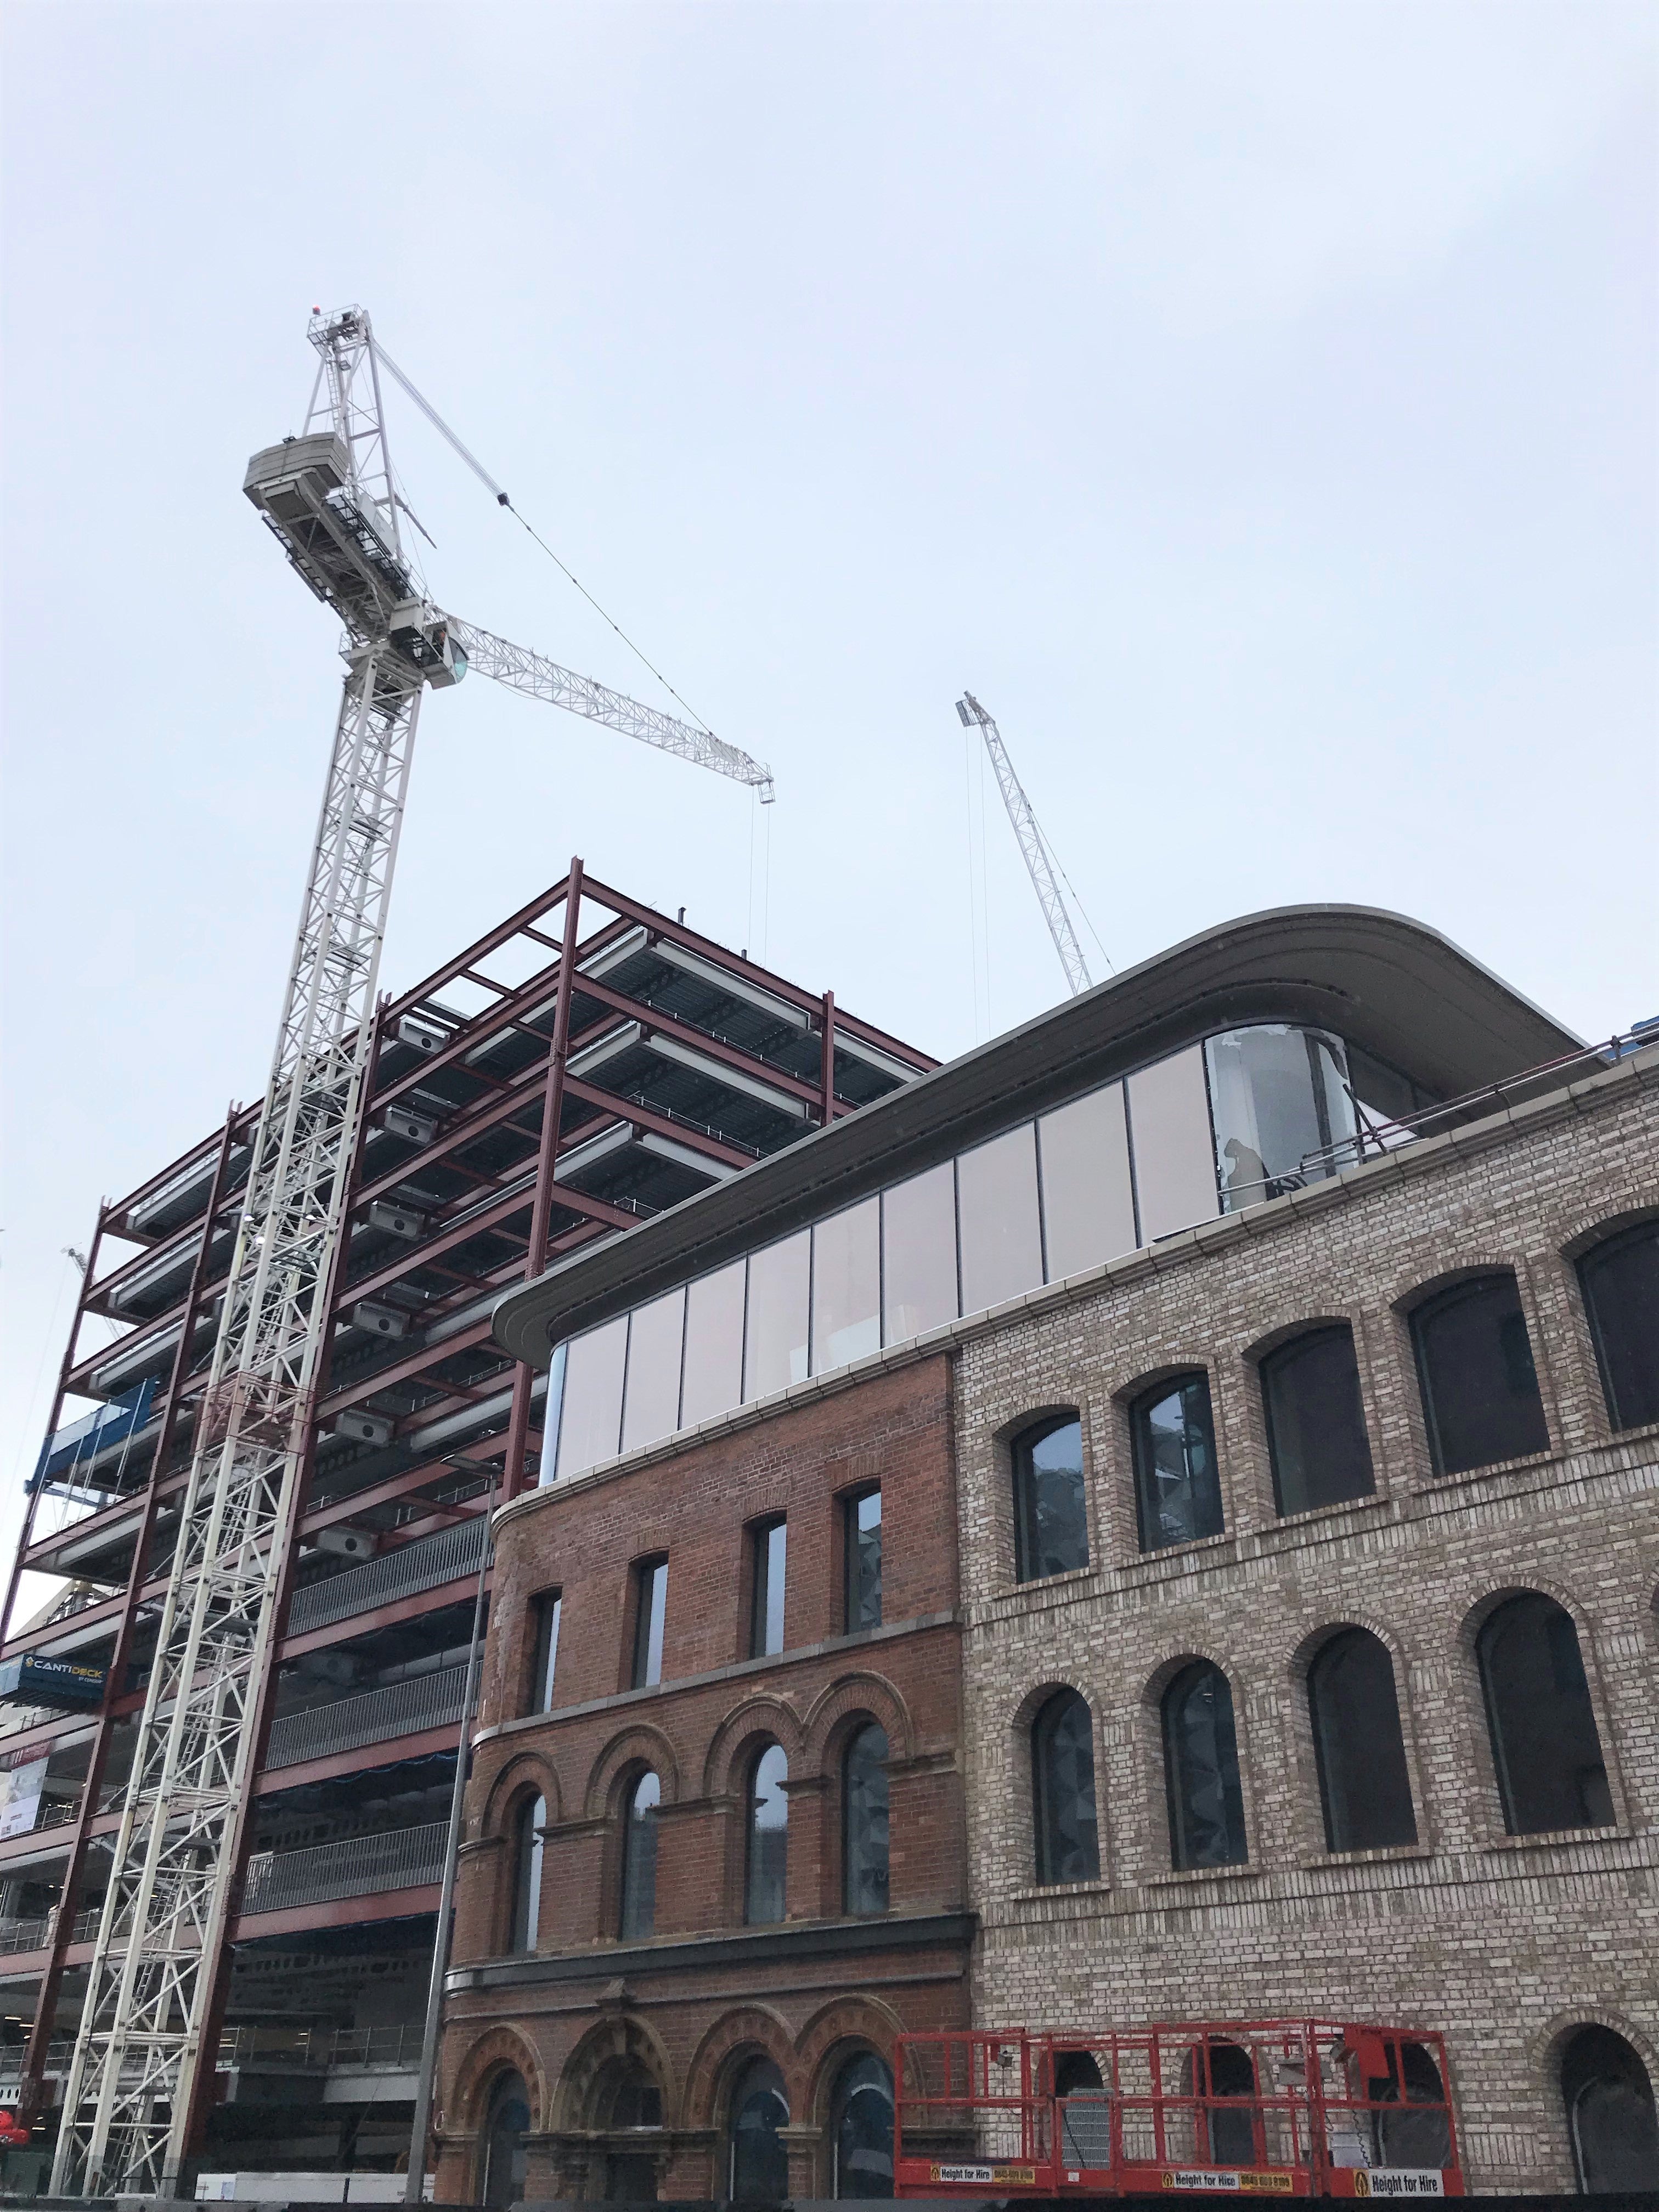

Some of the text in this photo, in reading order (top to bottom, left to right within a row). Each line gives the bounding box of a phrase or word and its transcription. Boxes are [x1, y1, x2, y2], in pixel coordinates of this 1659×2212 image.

[34, 1660, 103, 1678] CANTIDECK
[941, 2169, 963, 2181] Height
[964, 2169, 974, 2178] for
[976, 2169, 990, 2180] Hire
[1175, 2174, 1201, 2187] Height
[1204, 2175, 1216, 2186] for
[1218, 2175, 1235, 2186] Hire
[1372, 2175, 1438, 2196] Height for Hire
